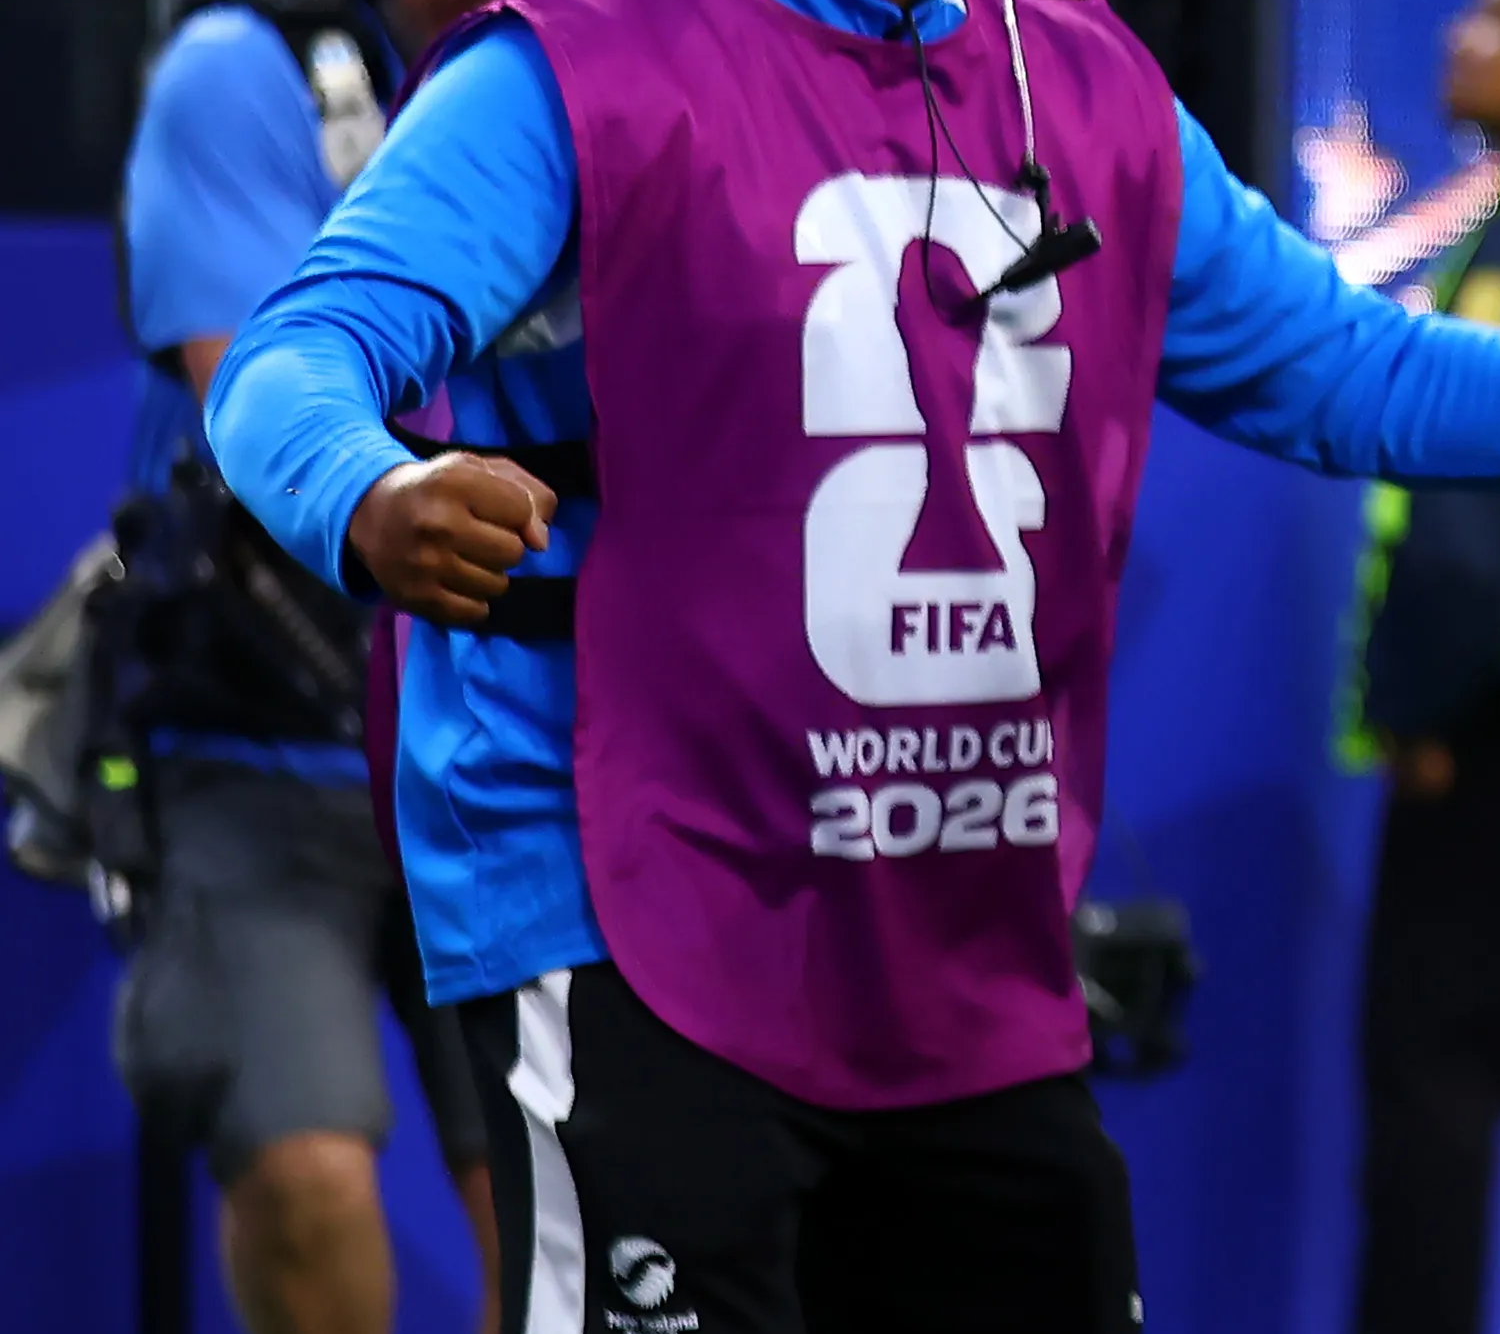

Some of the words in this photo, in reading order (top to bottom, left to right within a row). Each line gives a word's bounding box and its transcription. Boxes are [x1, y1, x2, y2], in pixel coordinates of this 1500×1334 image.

[890, 602, 1017, 656] FIFA
[806, 724, 982, 778] WORLD
[810, 772, 1060, 862] 2026
